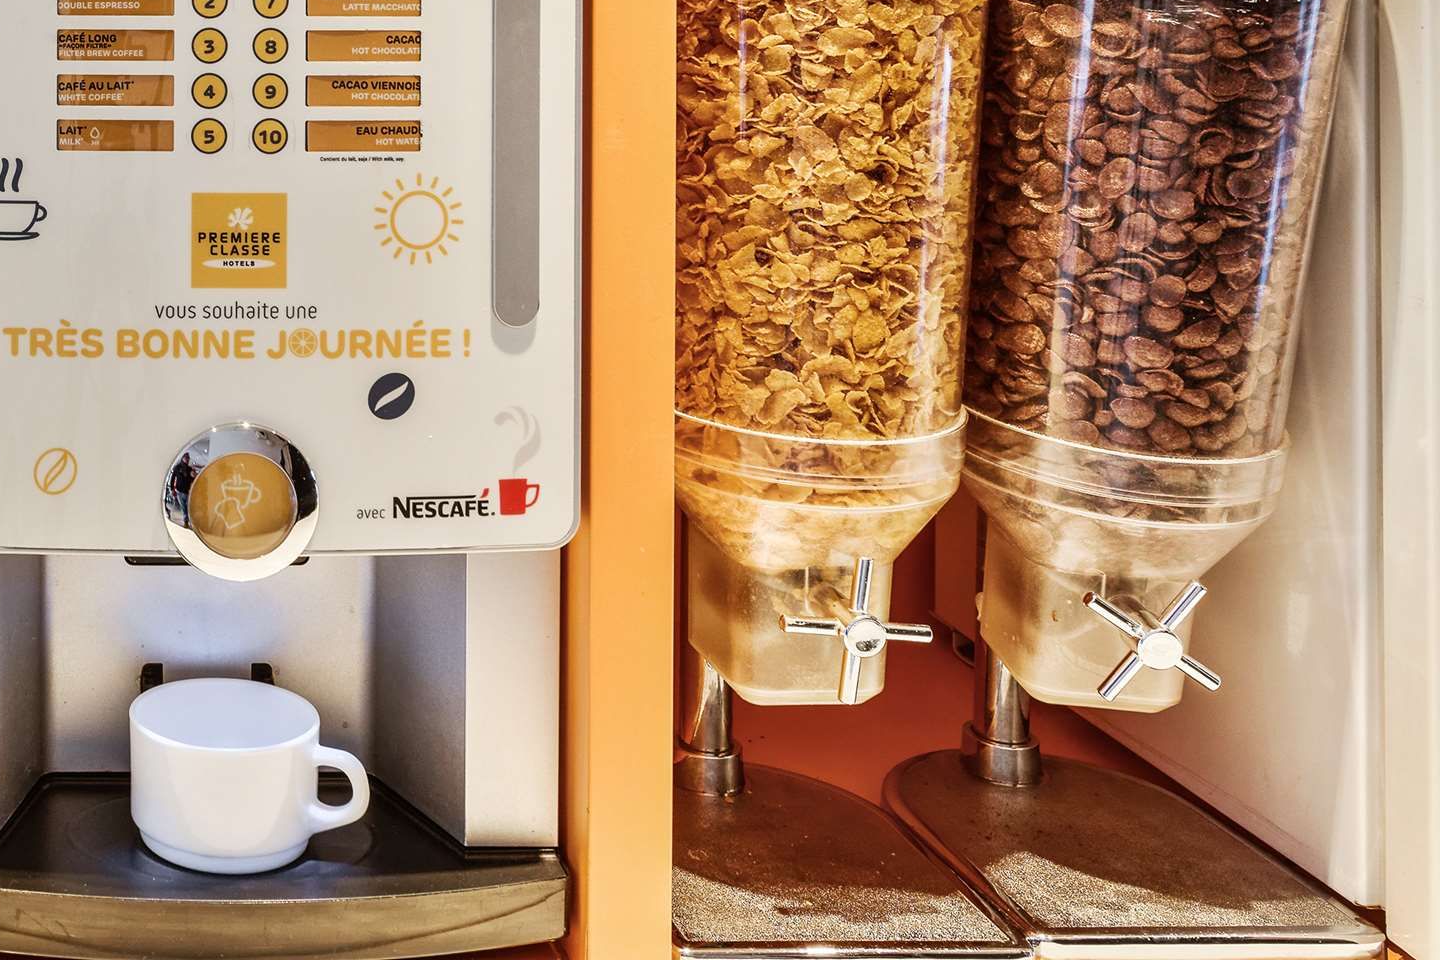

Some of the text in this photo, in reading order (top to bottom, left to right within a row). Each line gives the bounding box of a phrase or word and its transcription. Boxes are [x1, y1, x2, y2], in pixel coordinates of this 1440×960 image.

[58, 1, 140, 10] DOUBLE ESPRESSO
[342, 3, 370, 11] LATTE
[58, 32, 117, 43] CAFÉ LONG
[386, 35, 420, 44] CACAO
[203, 40, 214, 54] 3
[264, 40, 277, 54] 8
[352, 47, 369, 55] HOT
[58, 80, 86, 91] CAFÉ
[88, 82, 104, 90] AU
[332, 80, 420, 90] CACAO VIENNOIS
[58, 93, 86, 101] WHITE
[202, 84, 216, 100] 4
[264, 84, 277, 100] 9
[204, 130, 214, 144] 5
[258, 130, 282, 144] 10
[356, 126, 378, 136] EAU
[198, 231, 281, 244] PREMIERE
[210, 244, 271, 256] CLASSE
[222, 260, 256, 268] HOTELS
[154, 301, 318, 320] vous souhaite une
[2, 319, 104, 358] TRÈS
[116, 327, 256, 360] BONNE
[356, 508, 386, 520] avec
